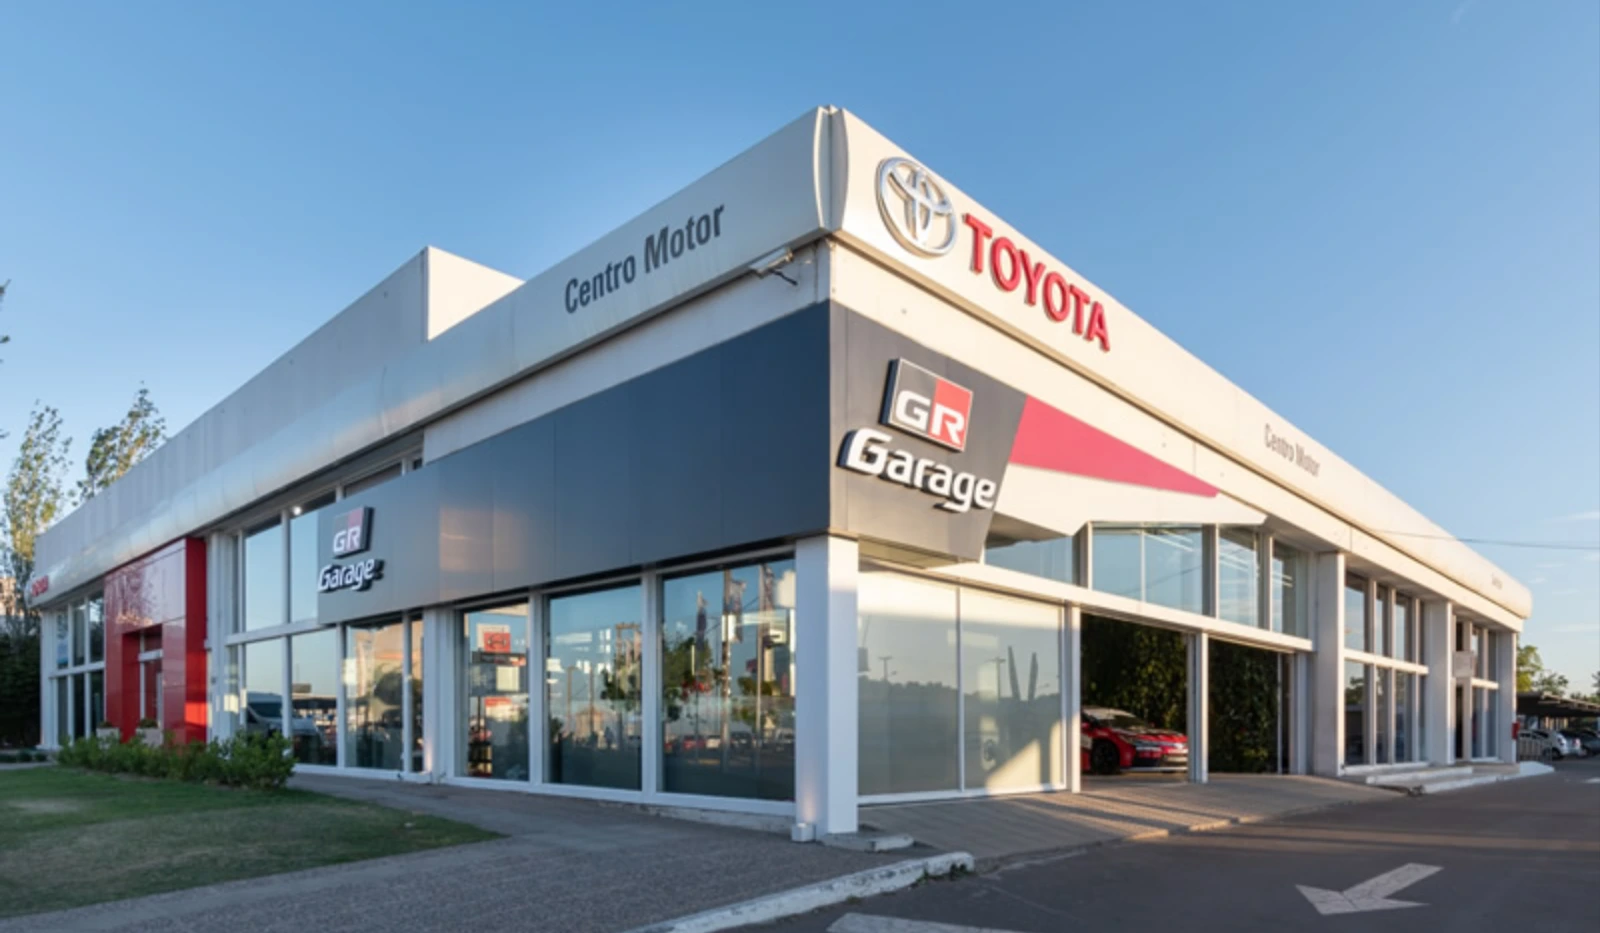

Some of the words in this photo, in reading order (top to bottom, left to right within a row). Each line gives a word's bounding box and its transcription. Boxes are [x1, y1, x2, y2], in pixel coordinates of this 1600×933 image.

[565, 254, 637, 314] Centro
[644, 205, 725, 274] Motor
[962, 213, 1110, 353] TOYOTA
[895, 390, 965, 444] GR
[846, 427, 997, 513] Garage
[333, 525, 361, 553] GR
[317, 559, 375, 592] Garage
